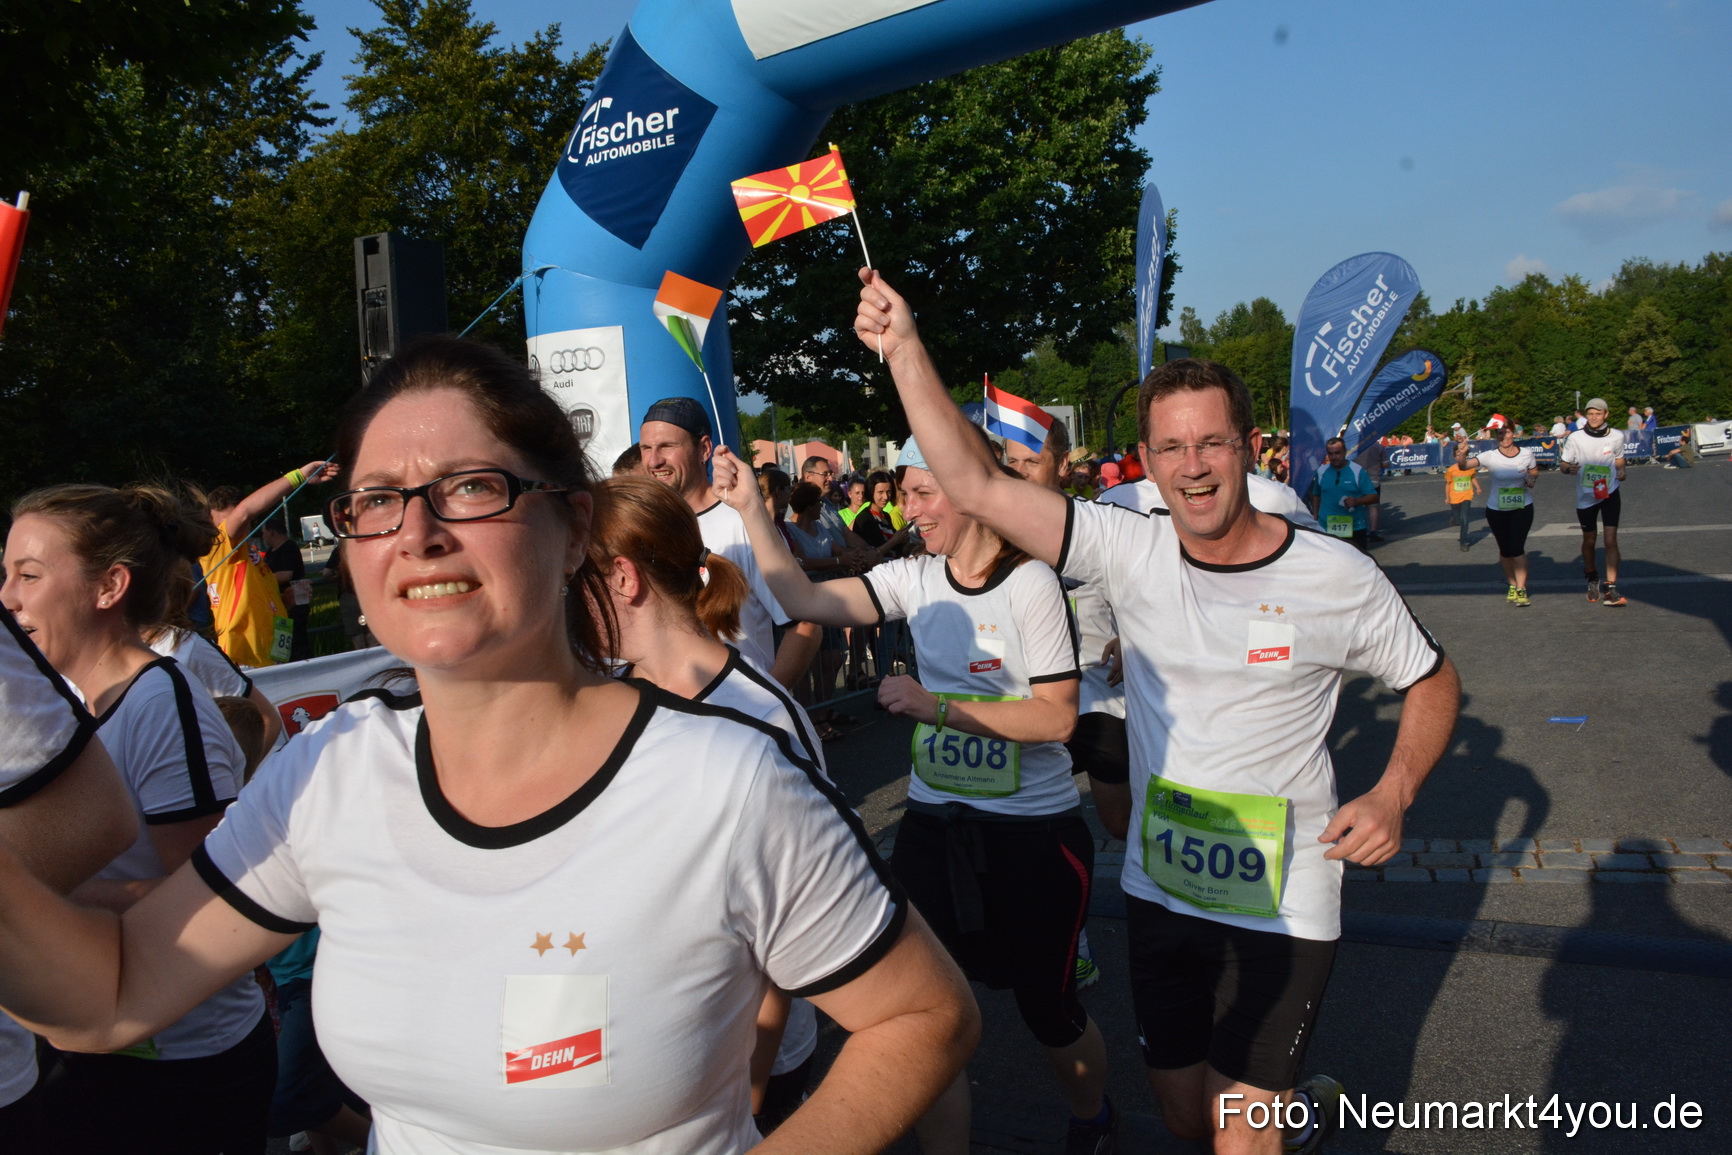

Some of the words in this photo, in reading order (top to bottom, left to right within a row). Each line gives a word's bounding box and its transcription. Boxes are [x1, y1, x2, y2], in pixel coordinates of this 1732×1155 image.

[578, 107, 680, 155] Fischer
[584, 133, 676, 167] AUTOMOBILE
[1320, 273, 1389, 379] Fischer
[1346, 290, 1399, 376] AUTOMOBILE
[553, 378, 574, 390] Audi
[1421, 376, 1442, 394] Medien
[1353, 382, 1418, 432] Frischmann
[573, 414, 592, 434] FIAT
[1397, 453, 1428, 463] Fischer
[1502, 495, 1522, 504] 1548
[1331, 524, 1348, 532] 417
[1258, 650, 1280, 660] DEHN
[977, 662, 993, 670] DEHN
[923, 732, 1008, 770] 1508
[933, 771, 966, 782] Annemarie
[966, 774, 996, 784] Altmann
[1156, 828, 1266, 883] 1509
[1183, 878, 1206, 892] Oliver
[1207, 886, 1229, 896] Born
[530, 1046, 575, 1070] DEHN
